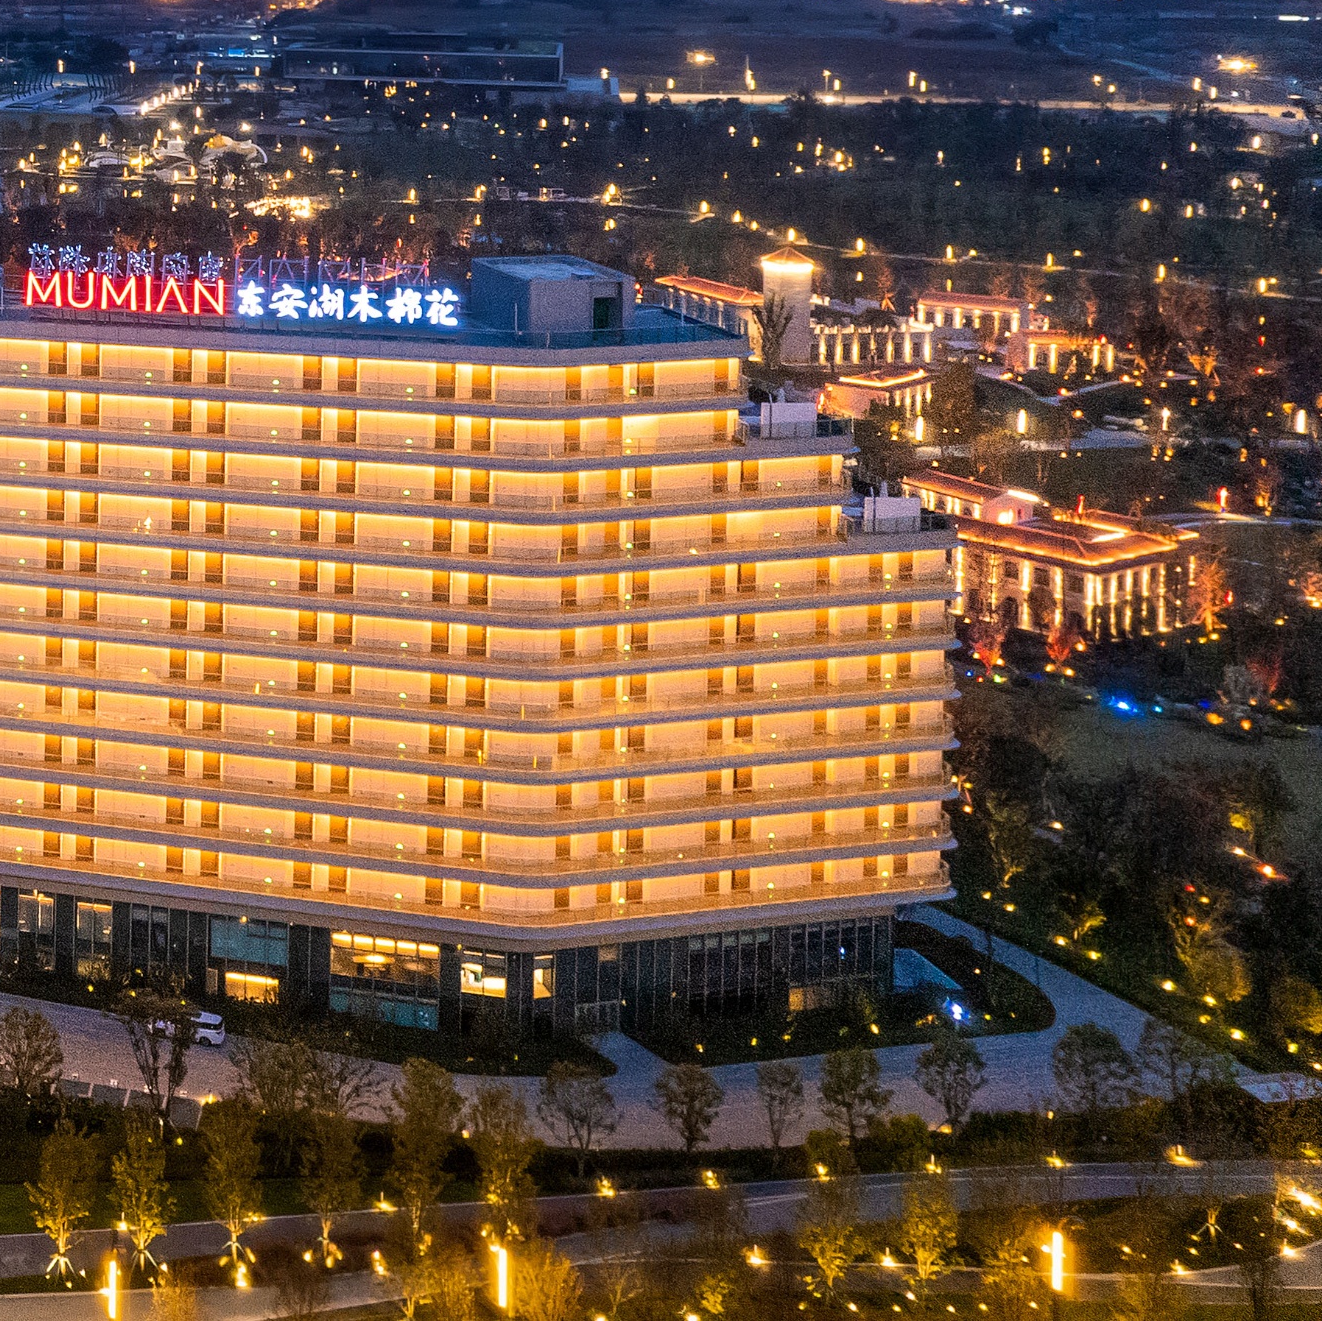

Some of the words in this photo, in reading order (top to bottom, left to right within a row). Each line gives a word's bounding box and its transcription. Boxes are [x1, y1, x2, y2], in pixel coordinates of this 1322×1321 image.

[25, 271, 225, 316] MUMIAN
[237, 280, 459, 326] 东安湖木棉花
